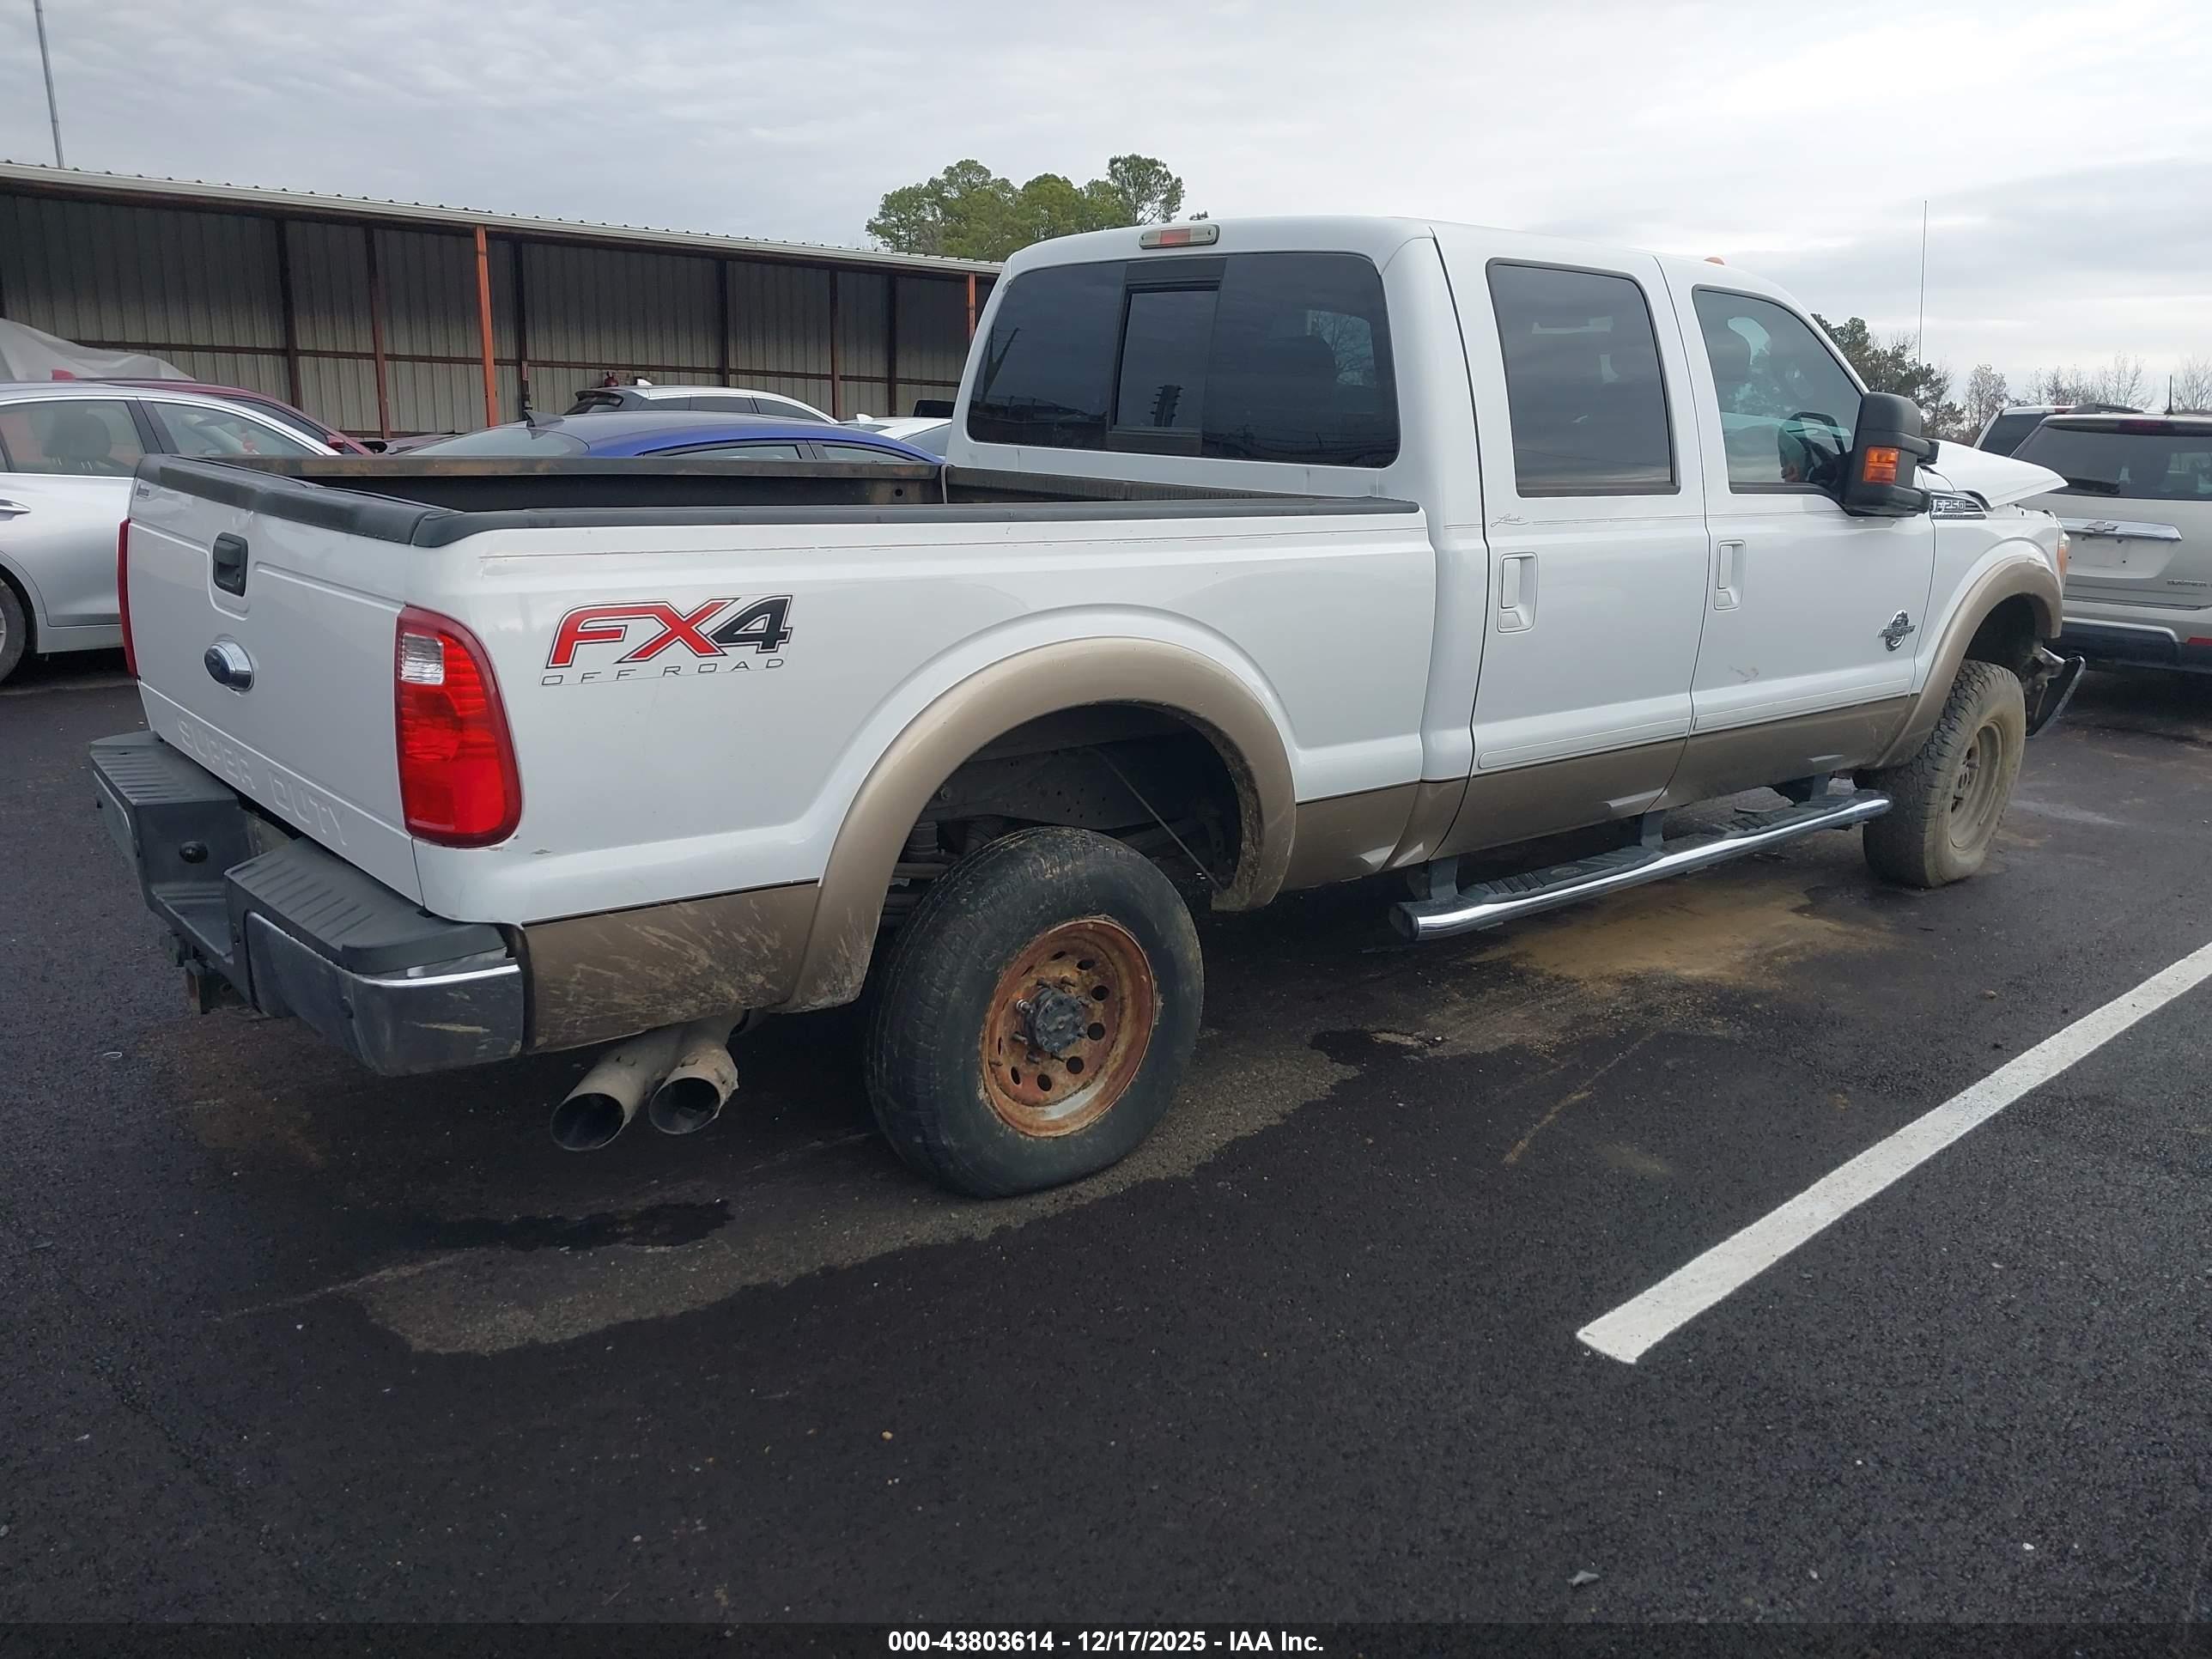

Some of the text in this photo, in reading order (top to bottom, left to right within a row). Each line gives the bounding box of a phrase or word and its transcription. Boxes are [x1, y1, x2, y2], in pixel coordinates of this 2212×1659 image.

[545, 594, 793, 669] FX4
[176, 716, 348, 847] SUPER DUTY
